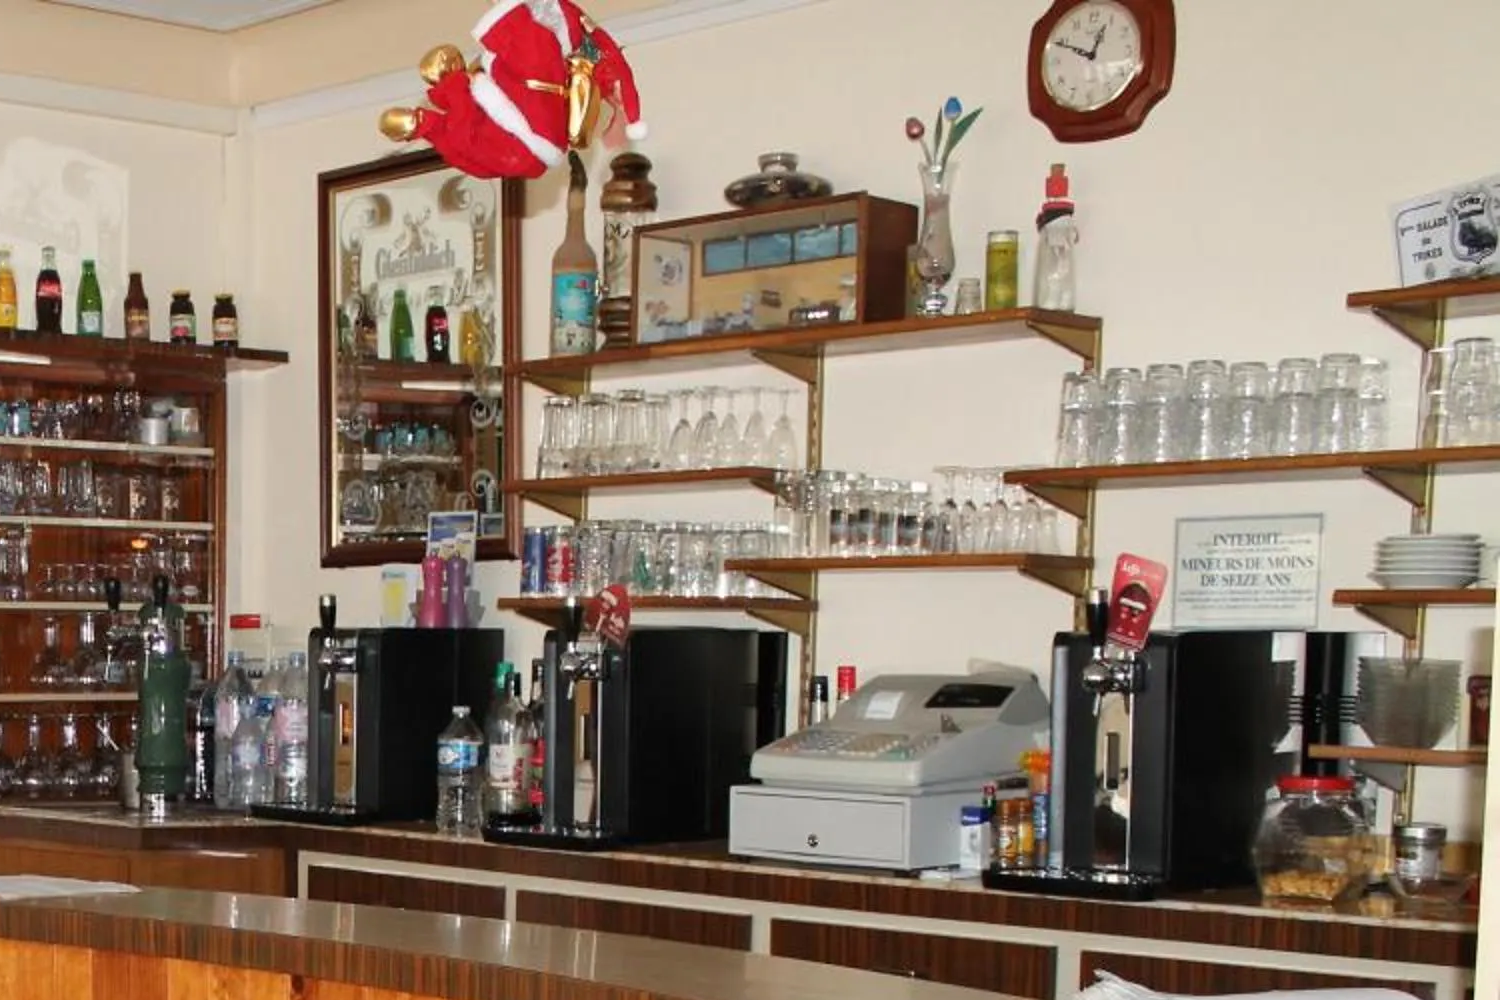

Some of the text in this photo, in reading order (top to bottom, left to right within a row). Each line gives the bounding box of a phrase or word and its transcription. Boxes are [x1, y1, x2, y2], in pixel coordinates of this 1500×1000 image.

[1213, 531, 1280, 547] INTERDIT
[1181, 555, 1315, 572] MINEURS DE MOINS
[1200, 572, 1292, 588] DE SEIZE ANS
